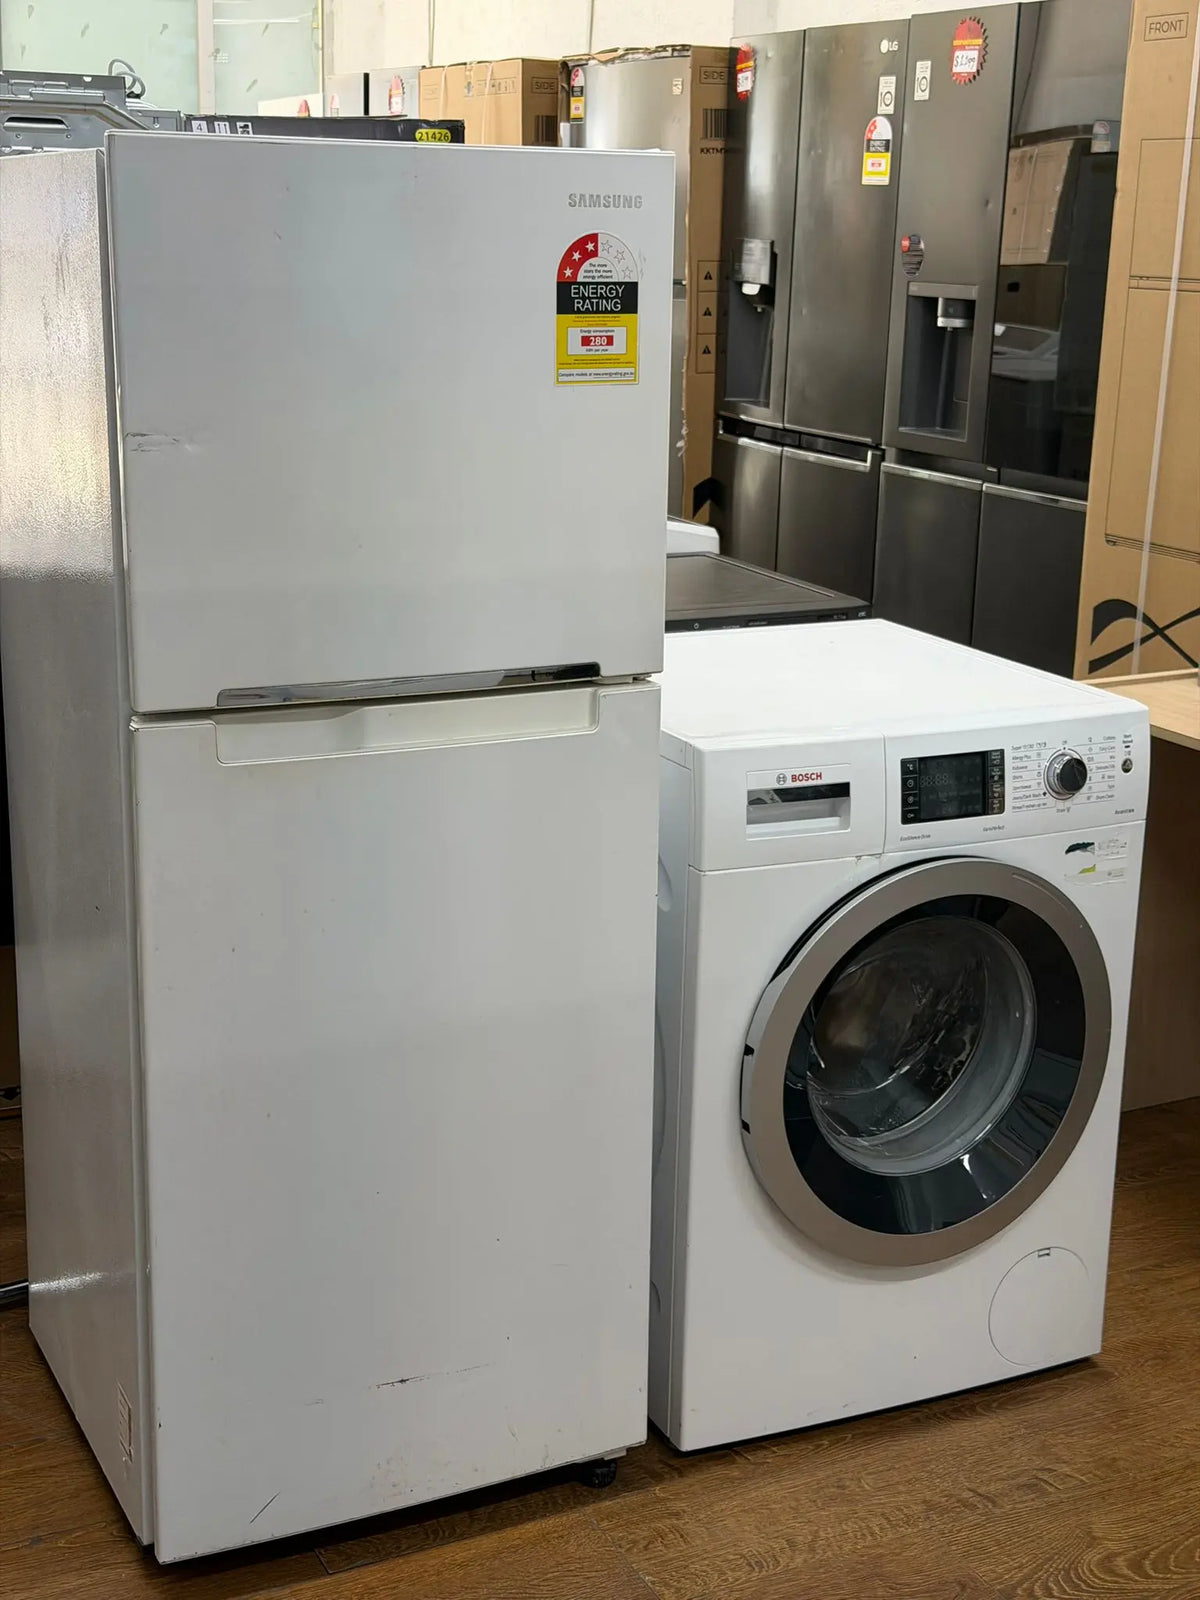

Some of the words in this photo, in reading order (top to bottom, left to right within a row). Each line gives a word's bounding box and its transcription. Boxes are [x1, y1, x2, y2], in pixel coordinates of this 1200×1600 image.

[1148, 20, 1184, 34] FRONT
[888, 41, 899, 51] LG
[703, 70, 726, 81] SIDE
[535, 79, 555, 90] SIDE
[418, 131, 450, 143] 21426
[567, 193, 643, 209] SAMSUNG
[571, 285, 625, 298] ENERGY
[574, 299, 621, 312] RATING
[589, 336, 608, 346] 280
[791, 772, 823, 783] BOSCH
